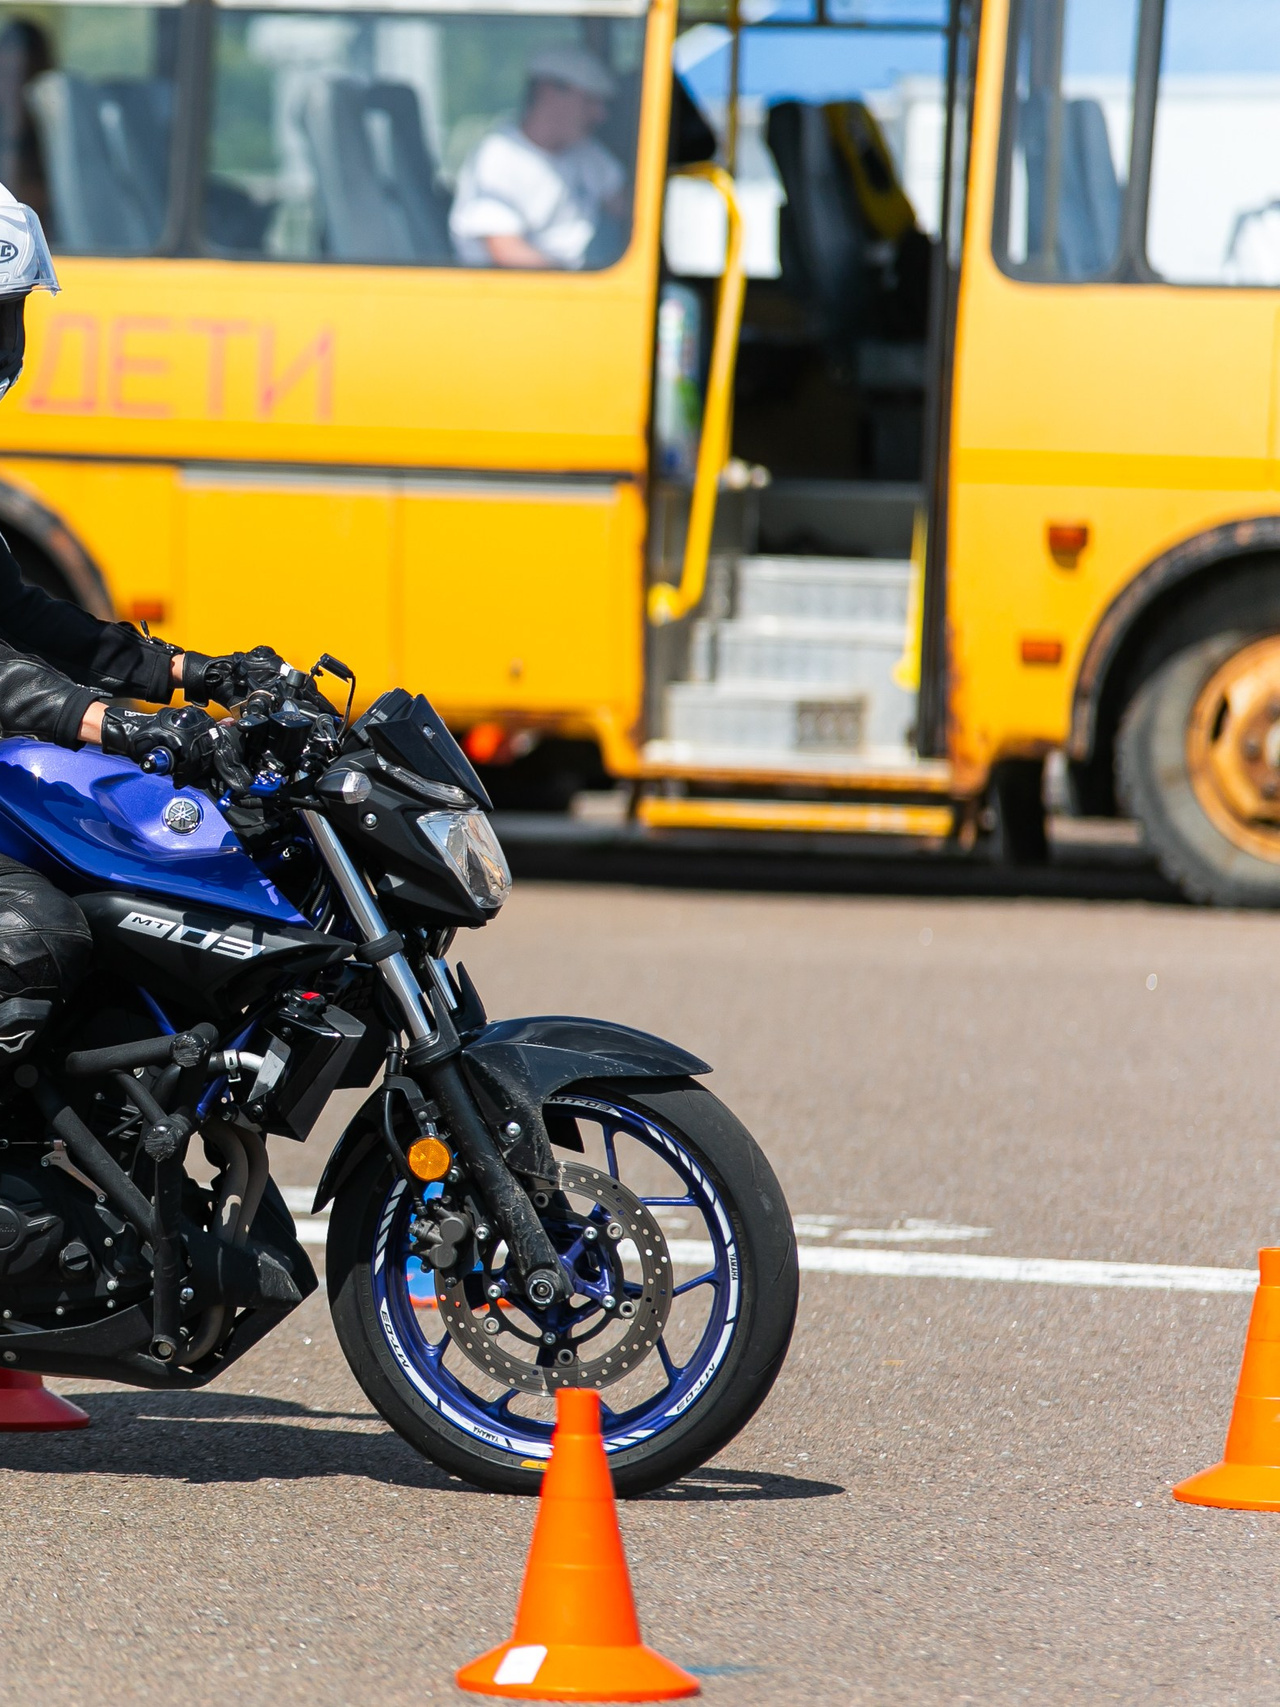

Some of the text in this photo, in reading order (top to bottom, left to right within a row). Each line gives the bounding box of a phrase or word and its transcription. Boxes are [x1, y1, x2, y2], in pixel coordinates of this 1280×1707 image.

[26, 316, 332, 424] ДЕТИ
[131, 916, 266, 960] MT 03
[728, 1252, 738, 1281] YAMAHA
[381, 1309, 410, 1368] MT-03
[676, 1363, 716, 1412] MT-03
[472, 1425, 499, 1443] YAMAHA
